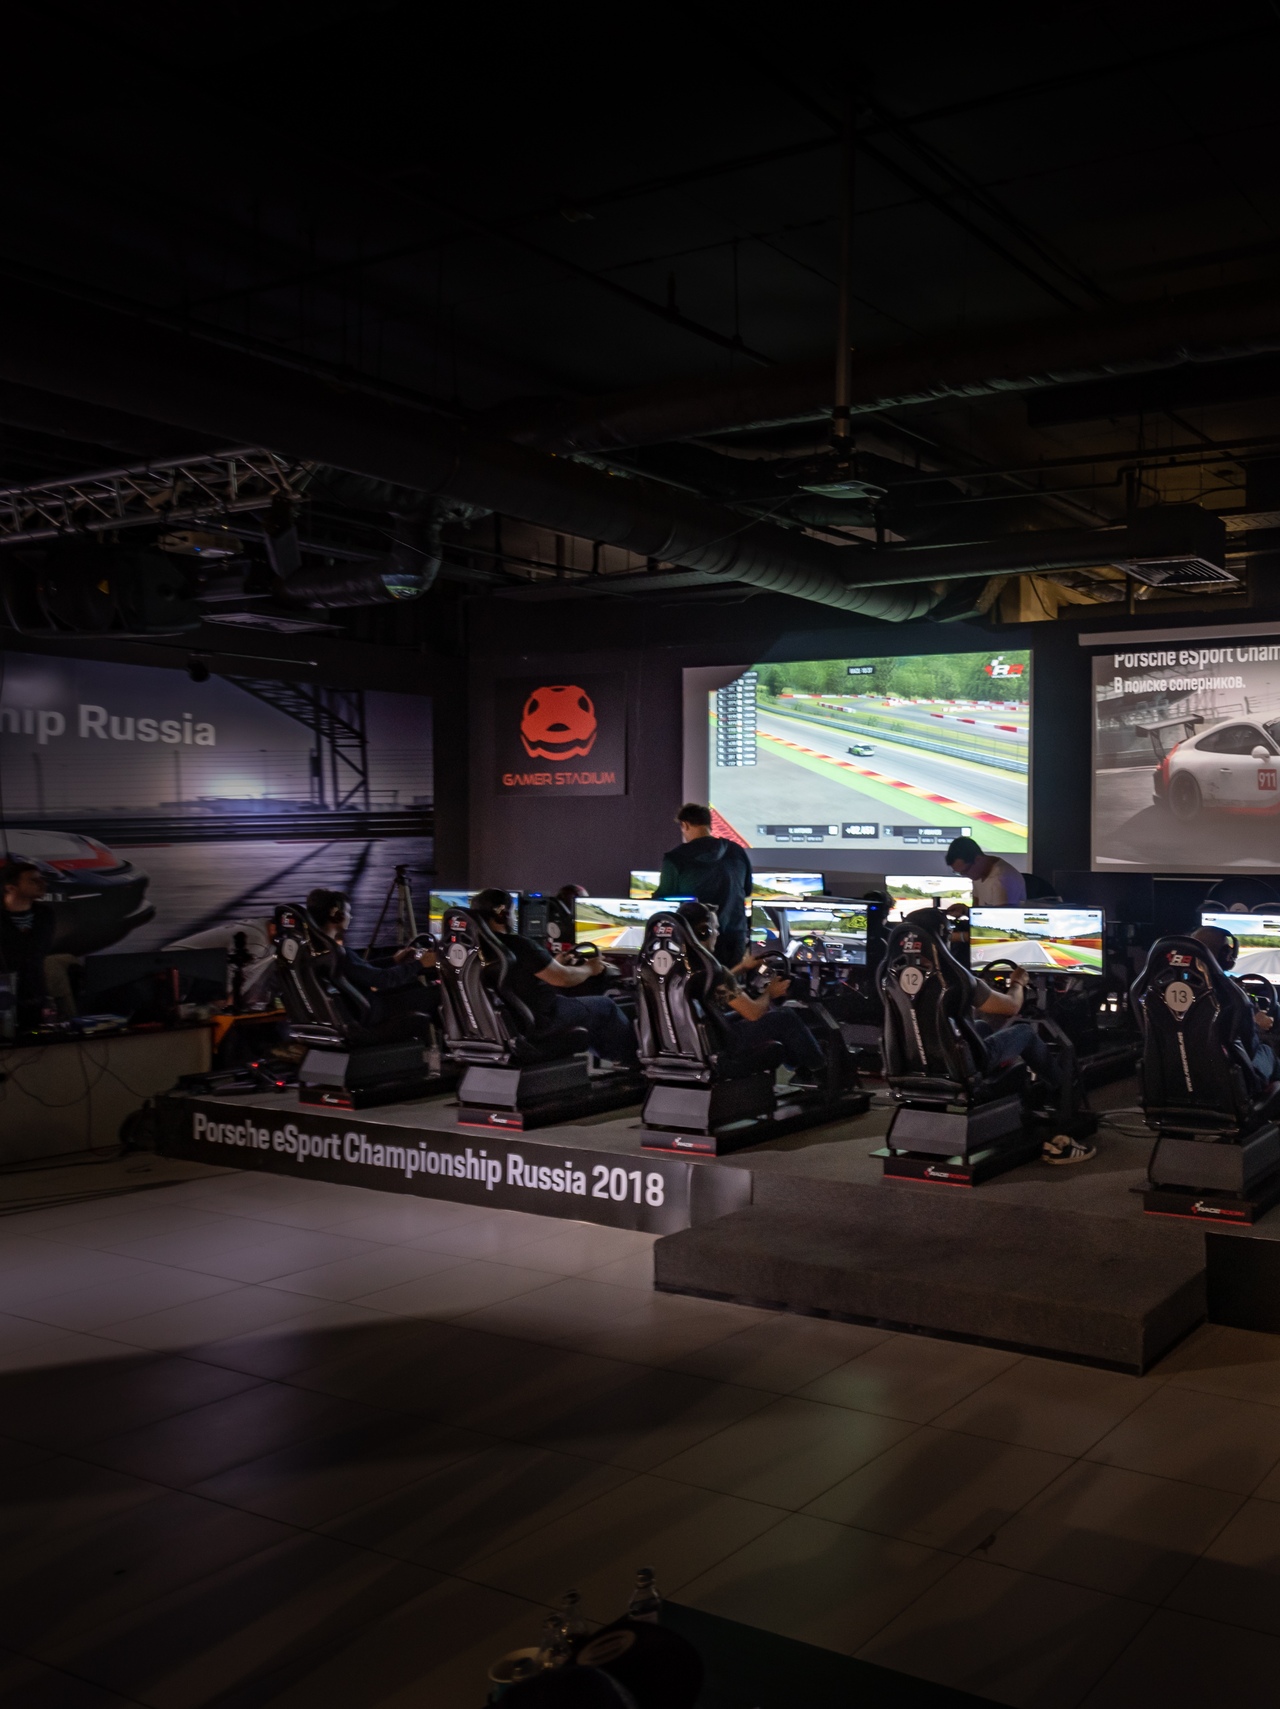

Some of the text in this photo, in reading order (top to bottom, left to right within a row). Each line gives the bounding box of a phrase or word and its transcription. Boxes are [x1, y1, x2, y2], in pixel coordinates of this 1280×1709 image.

[1180, 647, 1234, 671] eSport
[1113, 676, 1247, 695] В поиске соперников.
[79, 703, 217, 747] Russia
[502, 771, 617, 787] GAMER STADIUM
[1258, 772, 1277, 787] 911
[657, 957, 668, 968] 11
[905, 973, 919, 986] 12
[1171, 990, 1188, 1004] 13
[192, 1112, 665, 1207] Porsche eSport Championship Russia 2018
